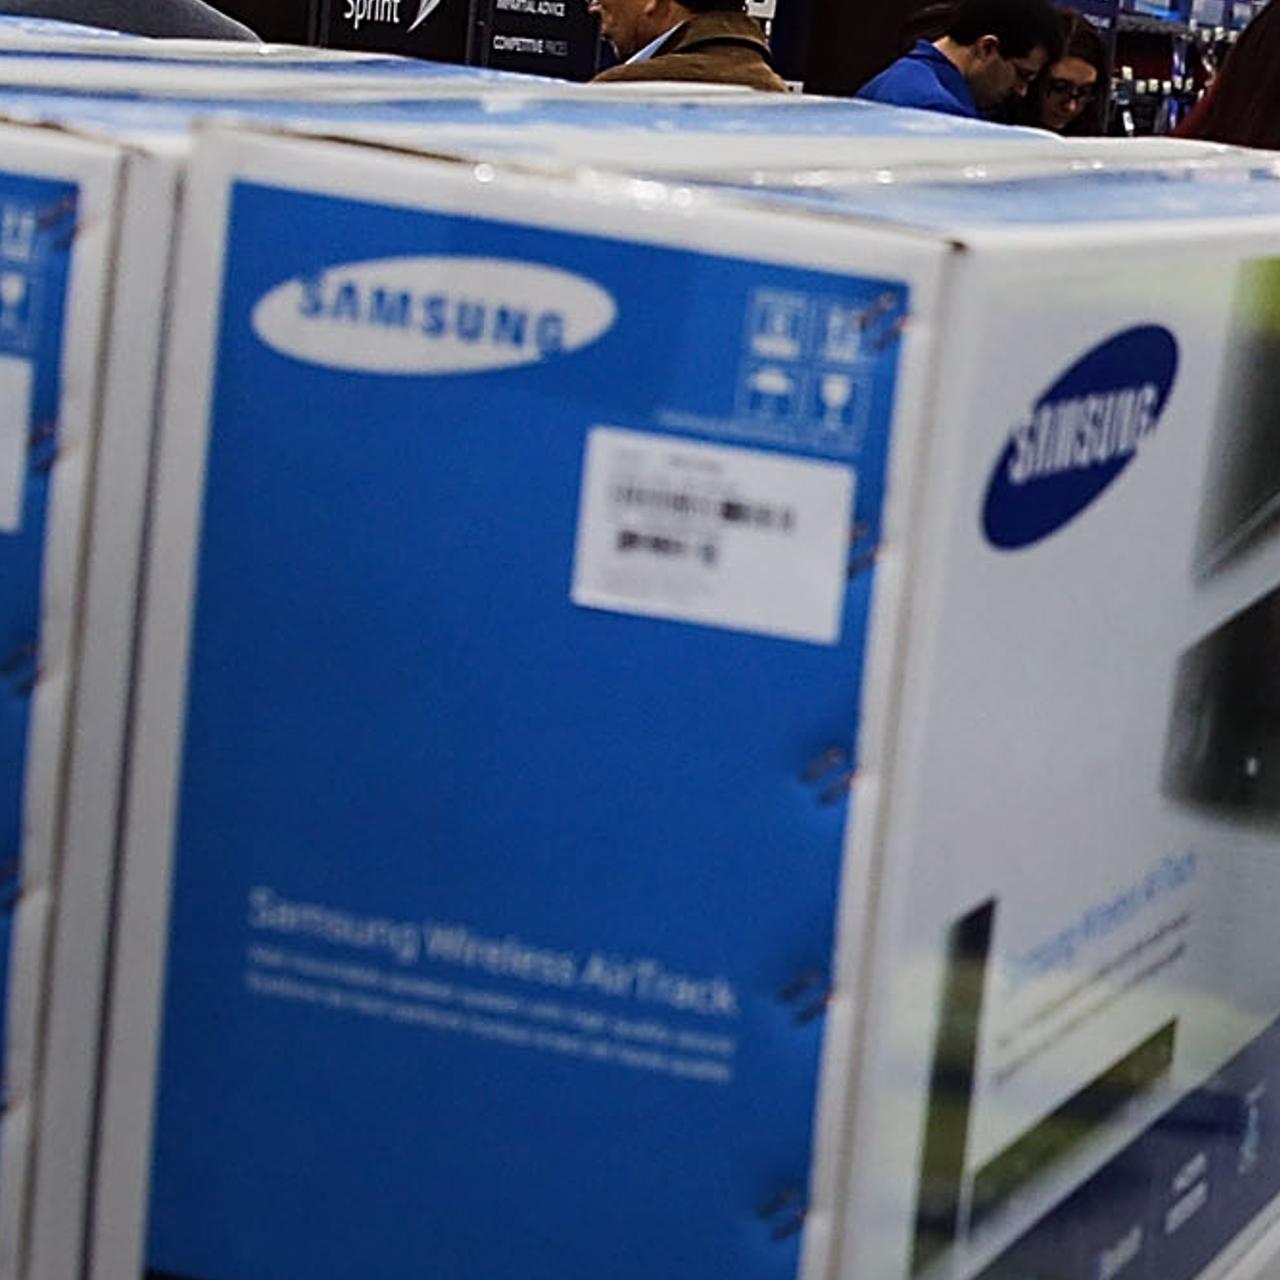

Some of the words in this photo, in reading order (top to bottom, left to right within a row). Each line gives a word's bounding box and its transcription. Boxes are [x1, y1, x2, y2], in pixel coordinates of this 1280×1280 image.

[298, 276, 567, 358] SAMSUNG
[1008, 381, 1159, 486] SAMSUNG
[248, 885, 421, 965] Samsung
[422, 920, 577, 987] Wireless
